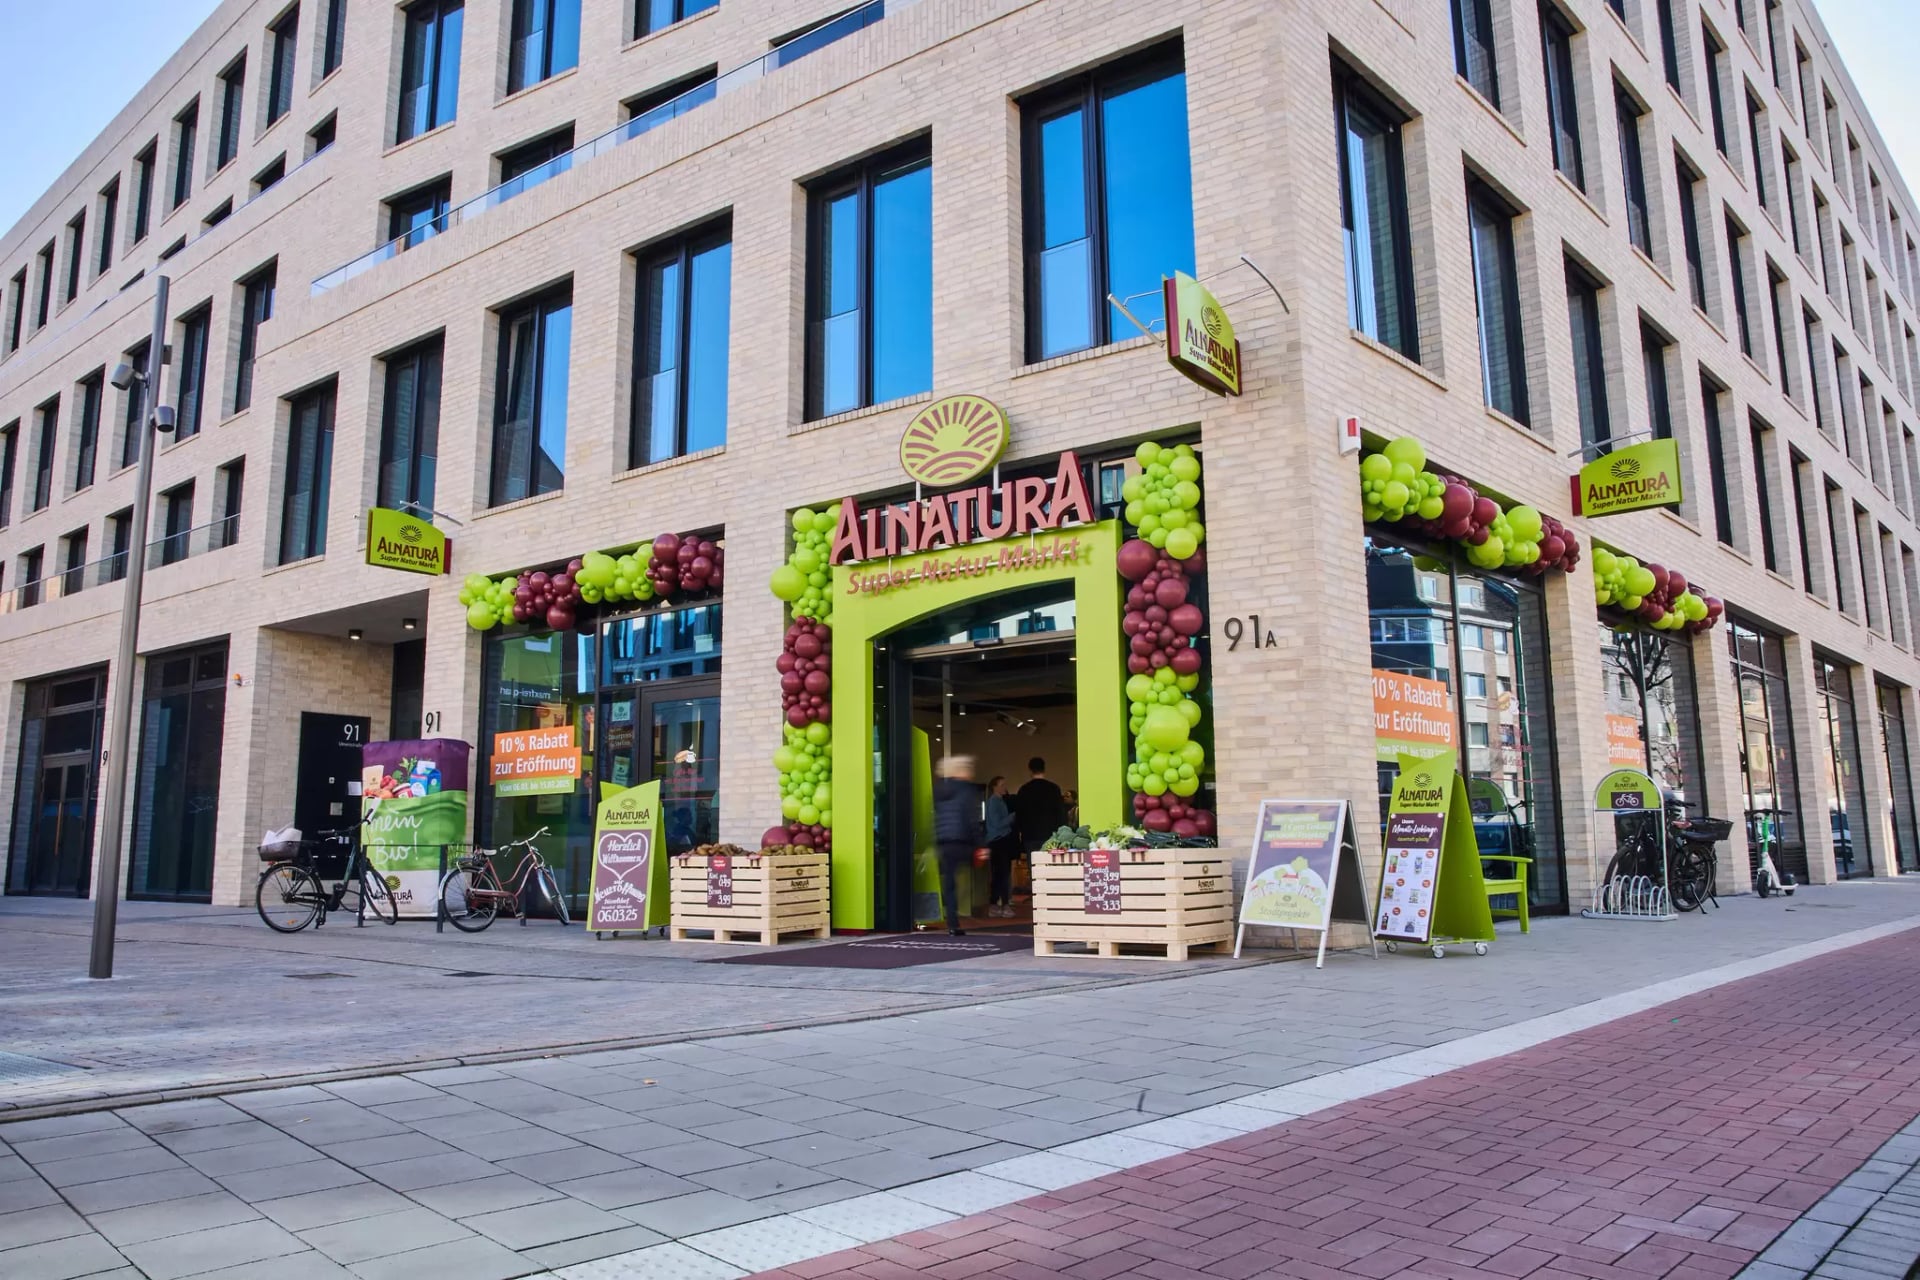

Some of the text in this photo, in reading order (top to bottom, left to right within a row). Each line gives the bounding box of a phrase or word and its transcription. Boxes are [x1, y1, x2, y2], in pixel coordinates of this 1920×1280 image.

[1185, 318, 1236, 375] ALNATURA
[1588, 471, 1671, 503] ALNATURA
[829, 451, 1096, 567] ALNATURA
[1592, 490, 1667, 510] Super Natur Markt
[376, 536, 440, 563] ALNATURA
[380, 553, 437, 570] Super Natur Markt
[847, 537, 1081, 597] Super Natur Markt
[1372, 676, 1442, 708] 10 % Rabatt
[343, 723, 360, 742] 91
[425, 711, 441, 734] 91
[1393, 709, 1451, 743] Eröffnung
[500, 732, 569, 754] 10 % Rabatt
[495, 755, 577, 775] zur Eröffnung
[1398, 786, 1443, 801] ALNATURA
[369, 805, 423, 832] mein
[605, 808, 650, 821] ALNATURA
[373, 831, 419, 865] Bio!
[606, 838, 642, 852] Herzlich
[602, 853, 643, 865] Willkommen
[595, 881, 646, 904] Neueröffnung
